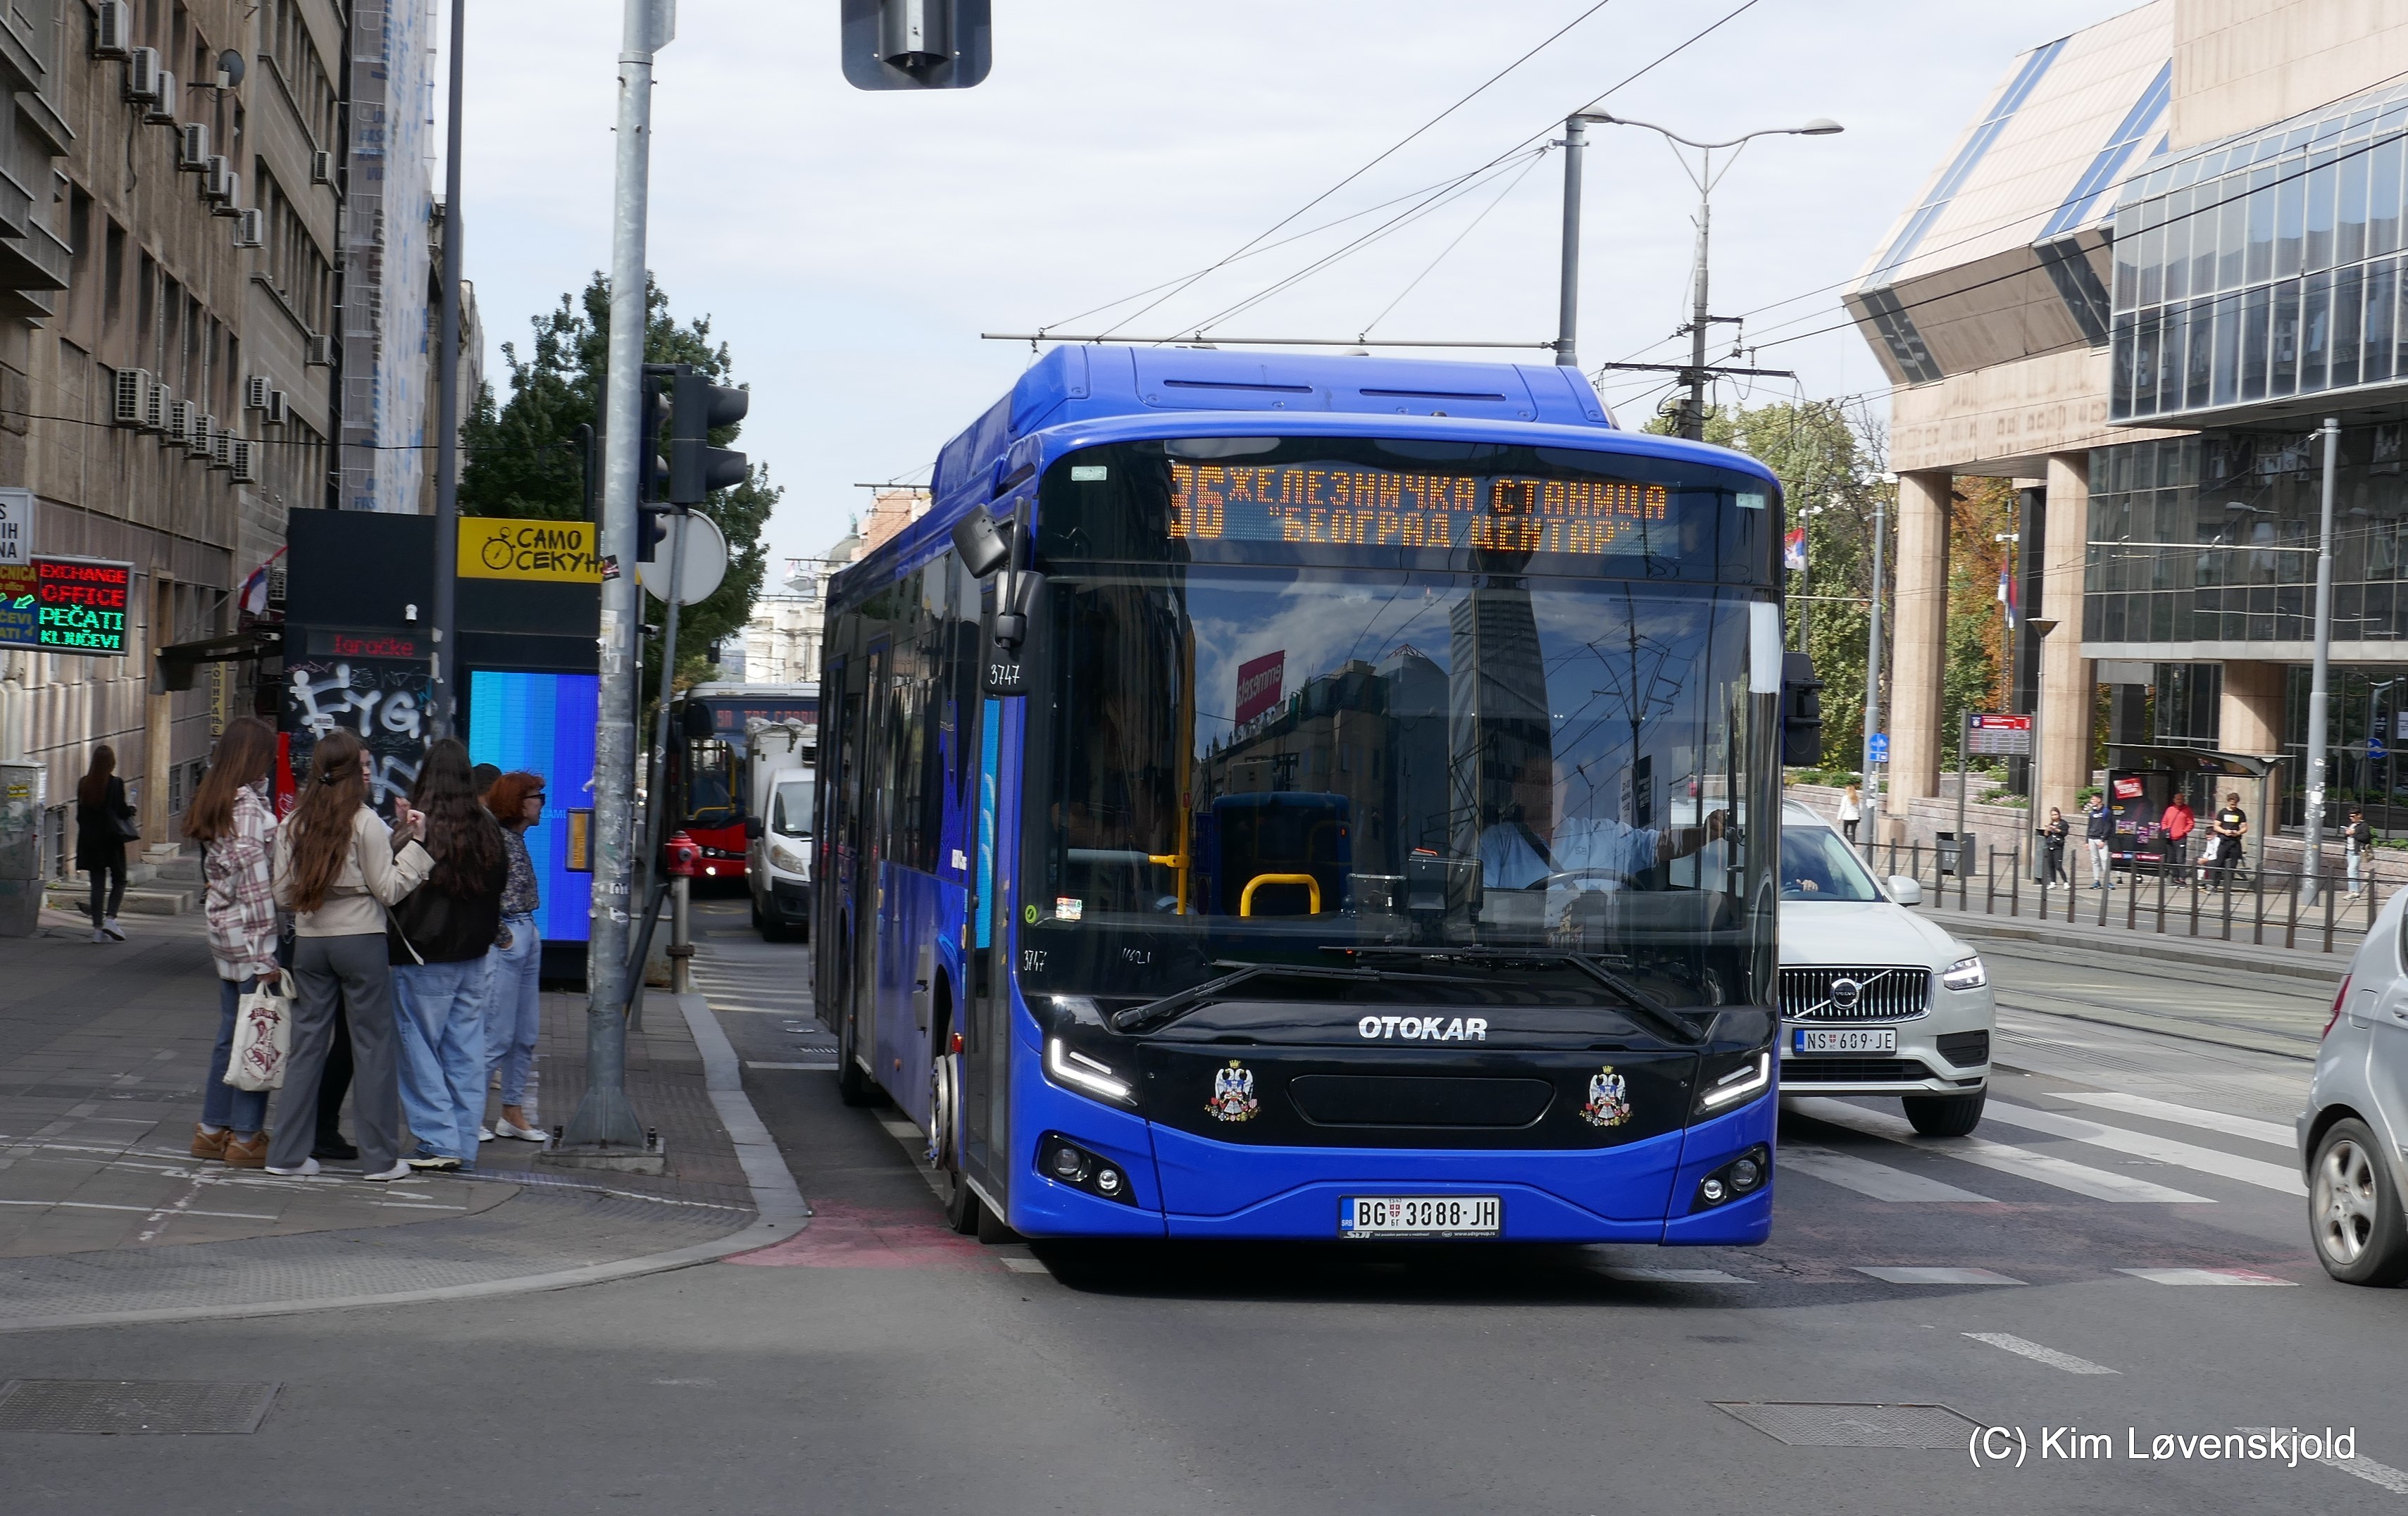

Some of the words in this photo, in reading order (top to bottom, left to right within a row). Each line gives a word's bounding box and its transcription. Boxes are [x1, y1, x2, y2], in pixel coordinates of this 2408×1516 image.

[1170, 465, 1224, 538] 36
[1228, 467, 1475, 512] ЖЕЛЕЗНИЧКА
[1494, 479, 1666, 520] СТАНИЦА
[517, 527, 582, 551] САМО
[40, 564, 127, 584] EXCHANGE
[516, 550, 603, 574] СЕКУН
[41, 584, 125, 607] OFFICE
[39, 605, 124, 630] PEČATI
[990, 664, 1021, 686] 3747
[1359, 1016, 1488, 1041] OTOKAR
[1807, 1033, 1826, 1049] NS
[1359, 1201, 1386, 1226] BG
